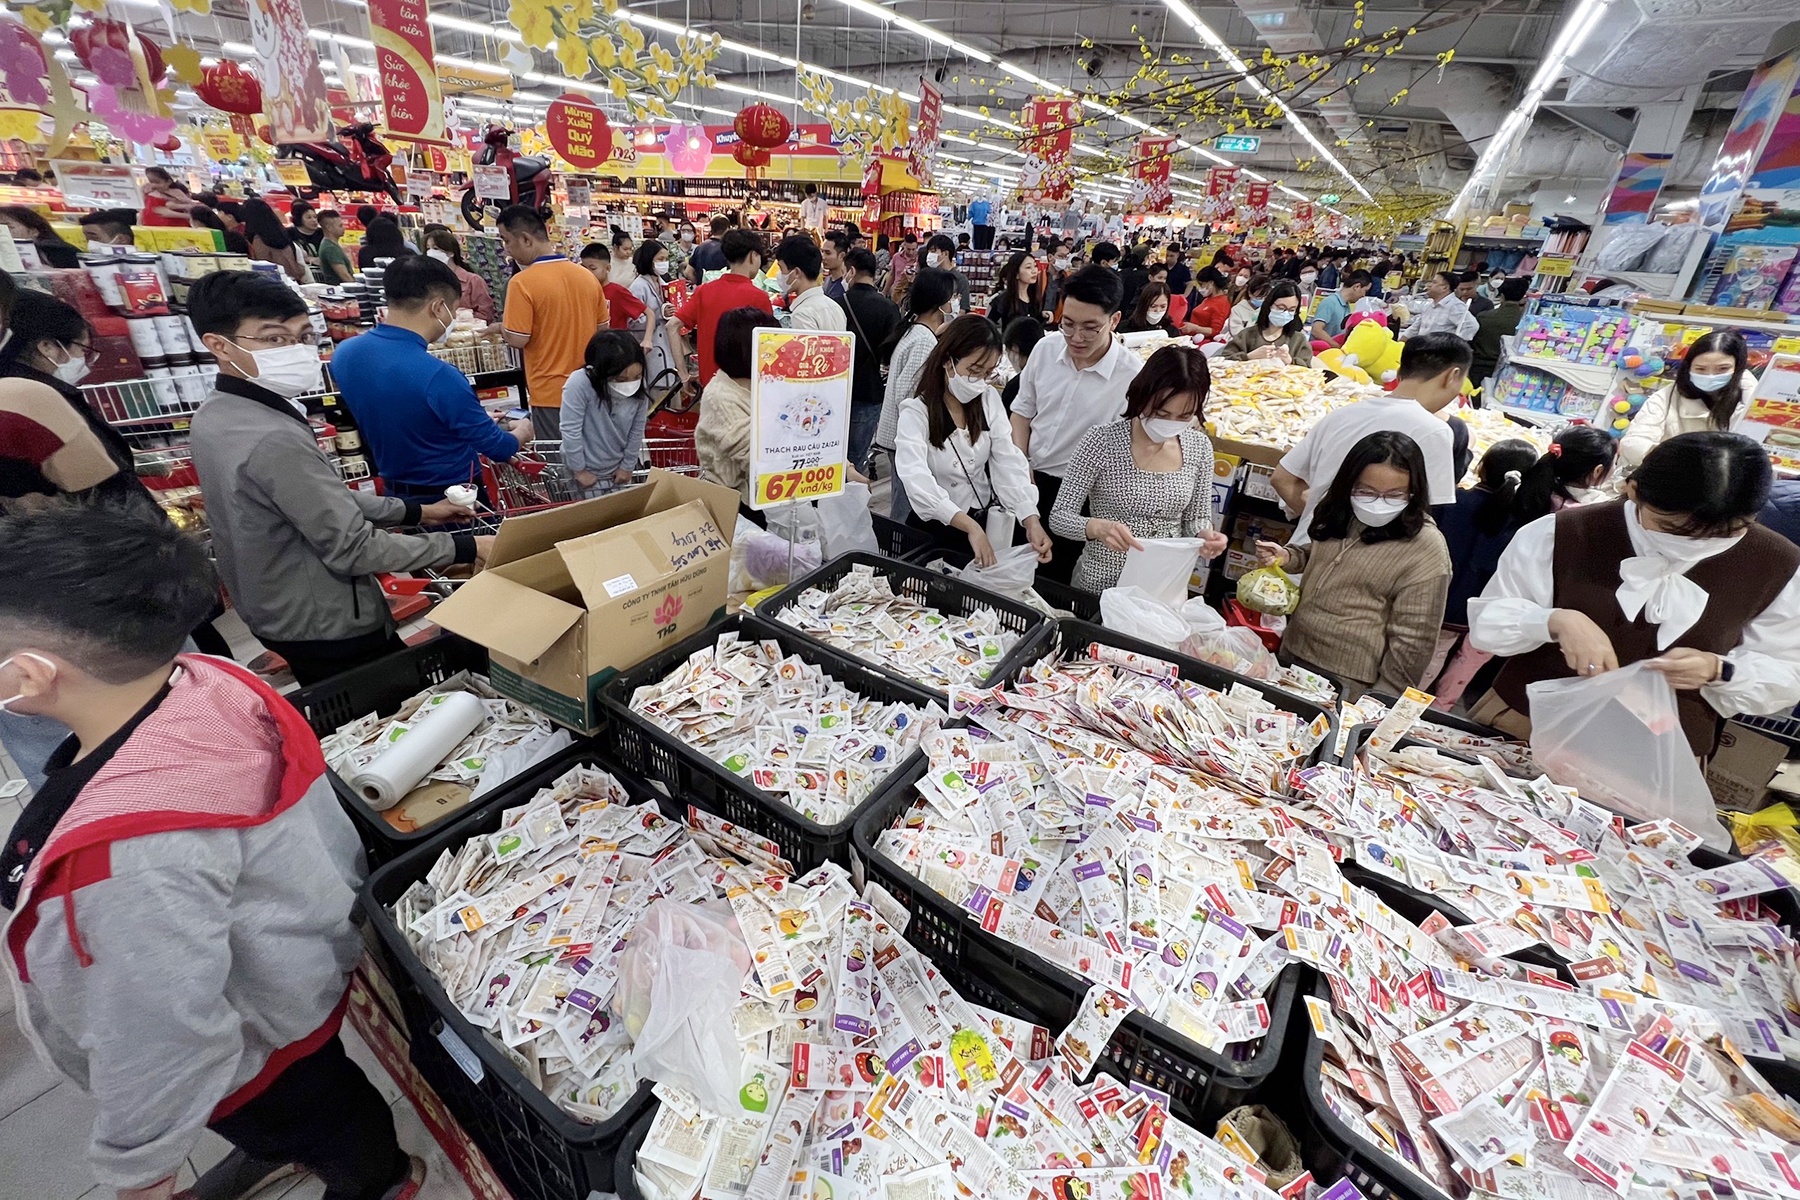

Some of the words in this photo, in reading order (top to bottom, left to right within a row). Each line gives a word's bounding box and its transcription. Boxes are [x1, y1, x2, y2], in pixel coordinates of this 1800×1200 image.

[400, 6, 419, 21] tân
[400, 24, 424, 37] niên
[391, 104, 414, 120] biên
[564, 105, 593, 121] Mừng
[567, 116, 592, 129] Xuân
[567, 129, 592, 145] Quý
[567, 143, 595, 158] Mão
[821, 440, 840, 449] ZAIZAI
[792, 456, 820, 470] 77.000
[800, 482, 833, 493] vnđ/kg
[622, 597, 640, 610] CÔNG
[642, 593, 649, 601] TY
[650, 584, 667, 597] TNHH
[667, 579, 680, 590] TÂM
[1574, 964, 1598, 974] TAMARIND
